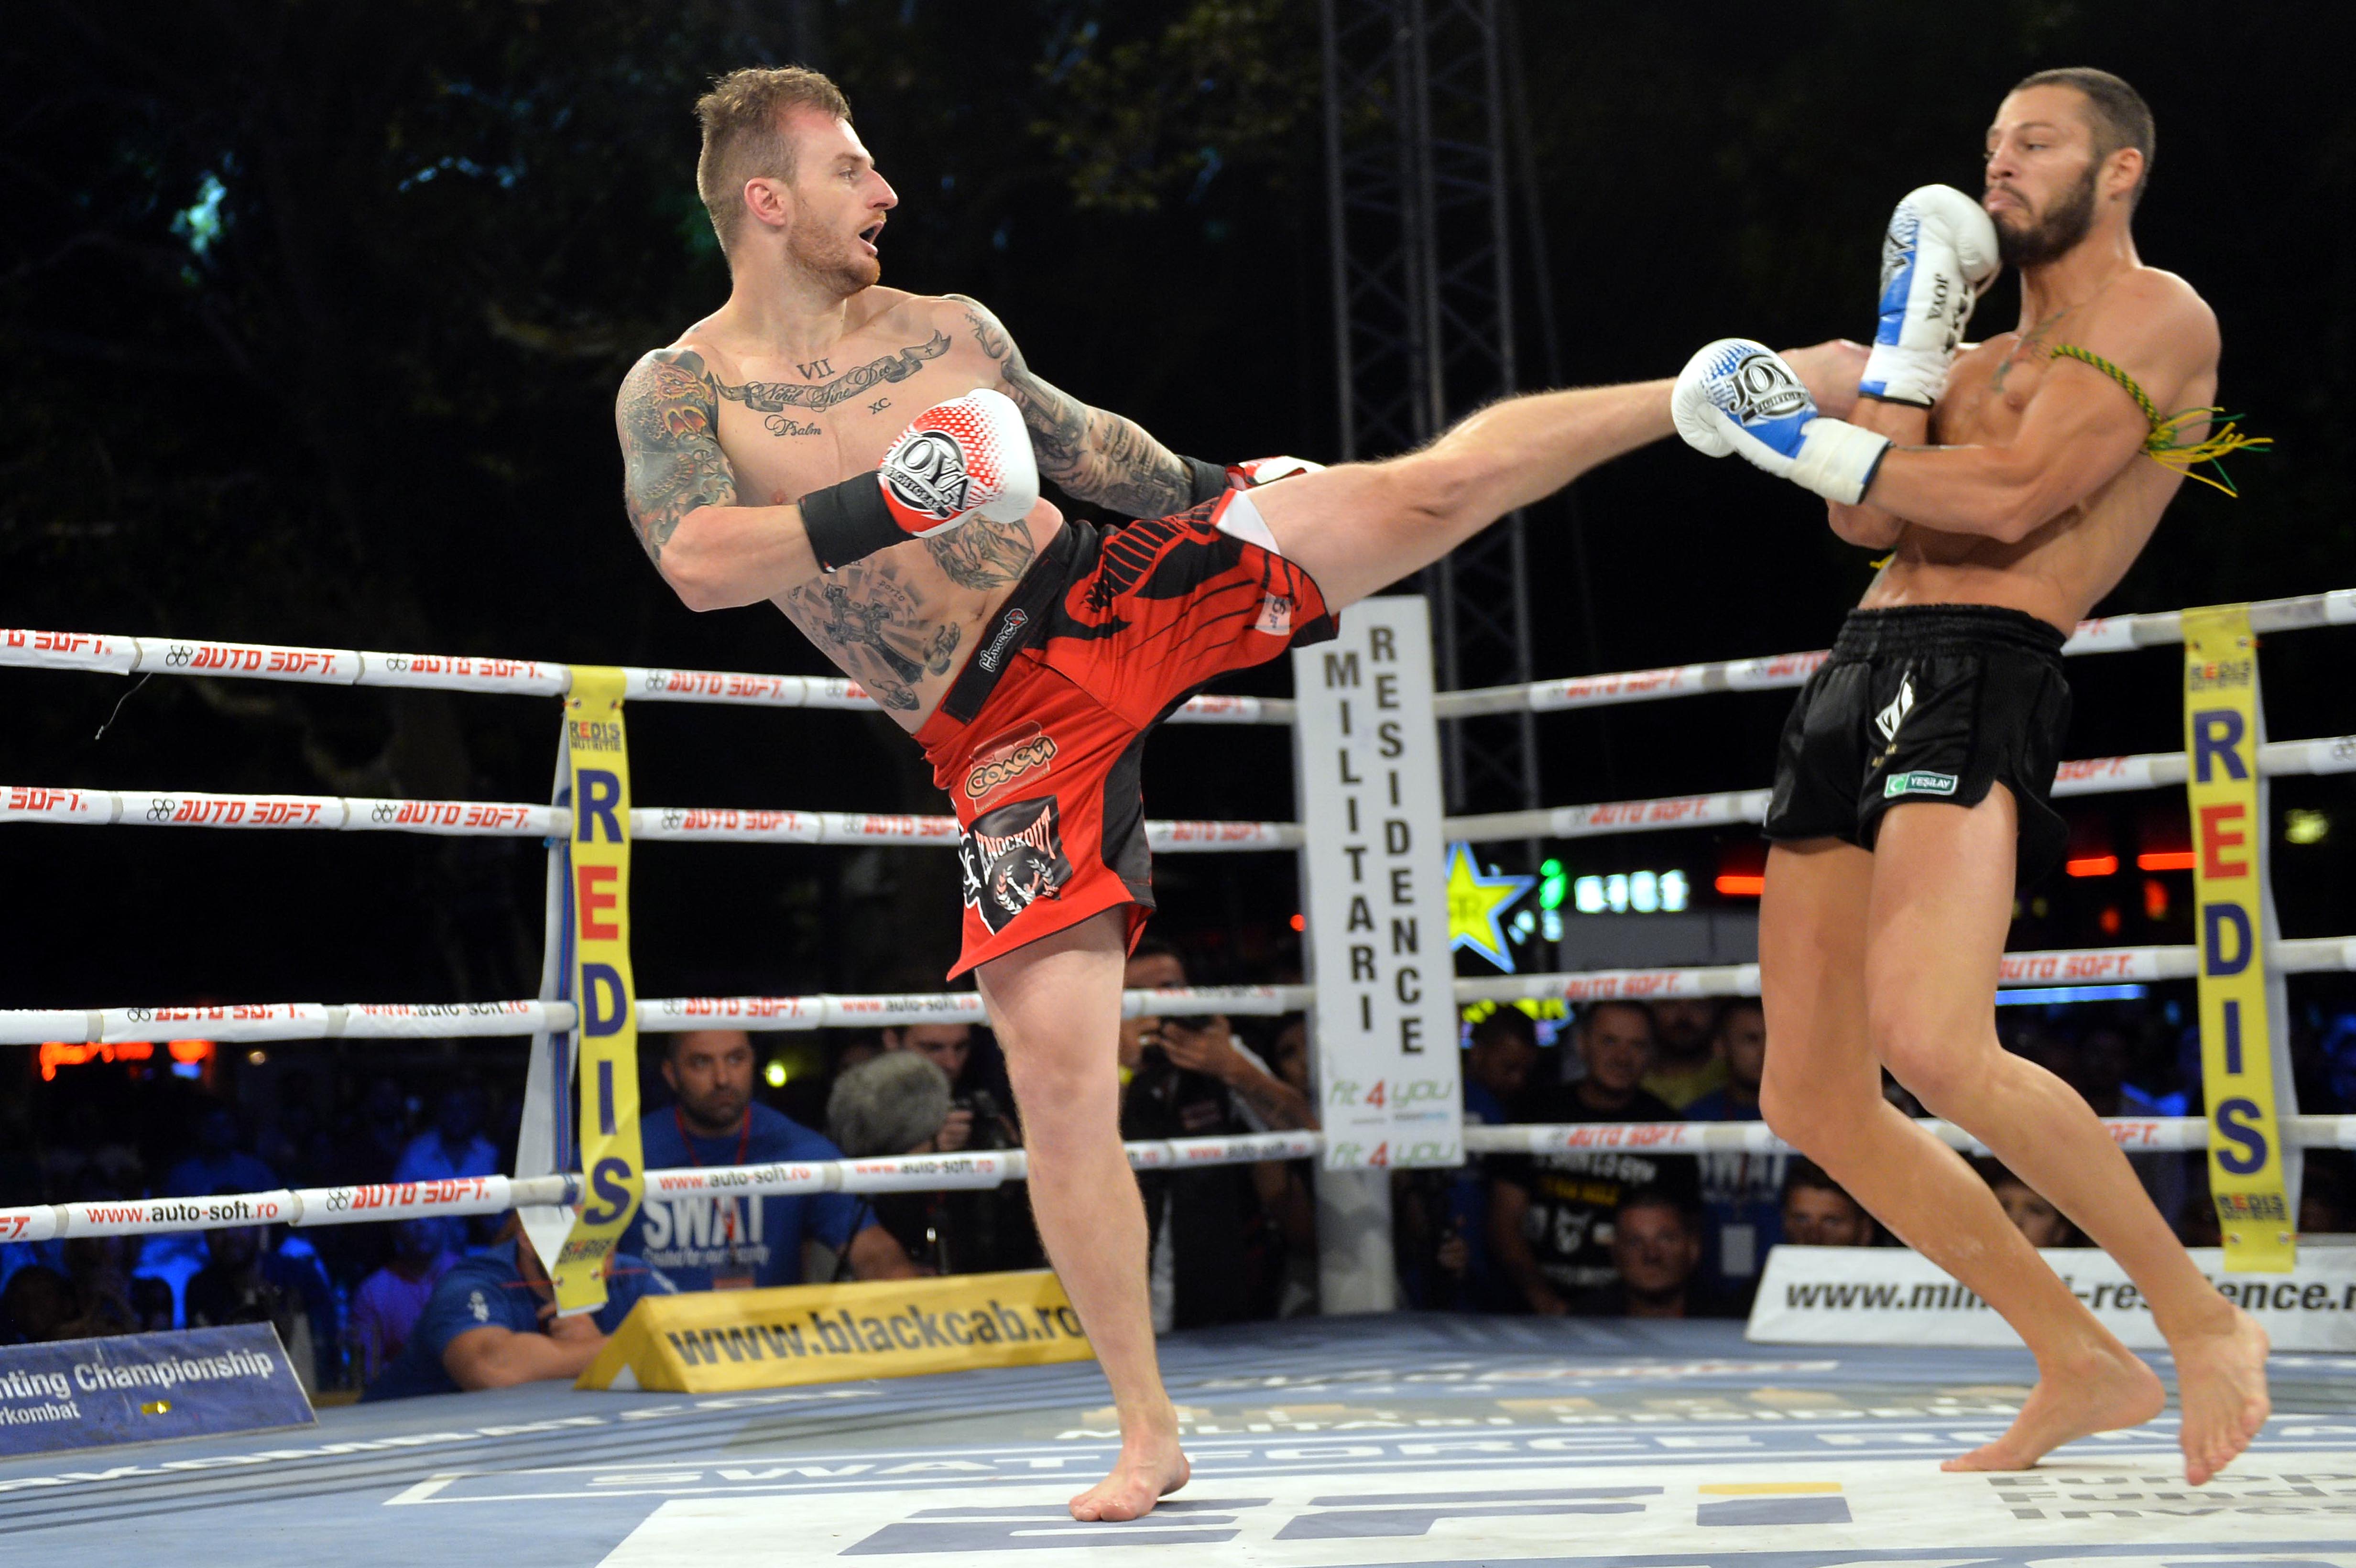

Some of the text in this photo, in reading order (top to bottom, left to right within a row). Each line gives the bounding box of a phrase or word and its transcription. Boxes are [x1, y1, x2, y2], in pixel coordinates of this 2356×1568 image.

[796, 358, 835, 381] VII
[765, 414, 821, 437] Psalm
[190, 646, 261, 670] AUTO
[667, 672, 727, 694] AUTO
[173, 799, 246, 822] AUTO
[395, 802, 461, 825] AUTO
[683, 809, 739, 831] AUTO
[1323, 651, 1375, 1031] MILITARI
[1369, 626, 1425, 1055] RESIDENCE
[2193, 709, 2268, 1176] REDIS
[576, 768, 633, 1226] REDIS
[1365, 1080, 1385, 1109] 4
[351, 1183, 417, 1209] AUTO
[86, 1202, 278, 1223] www.auto-soft.ro
[73, 1348, 274, 1393] Championship
